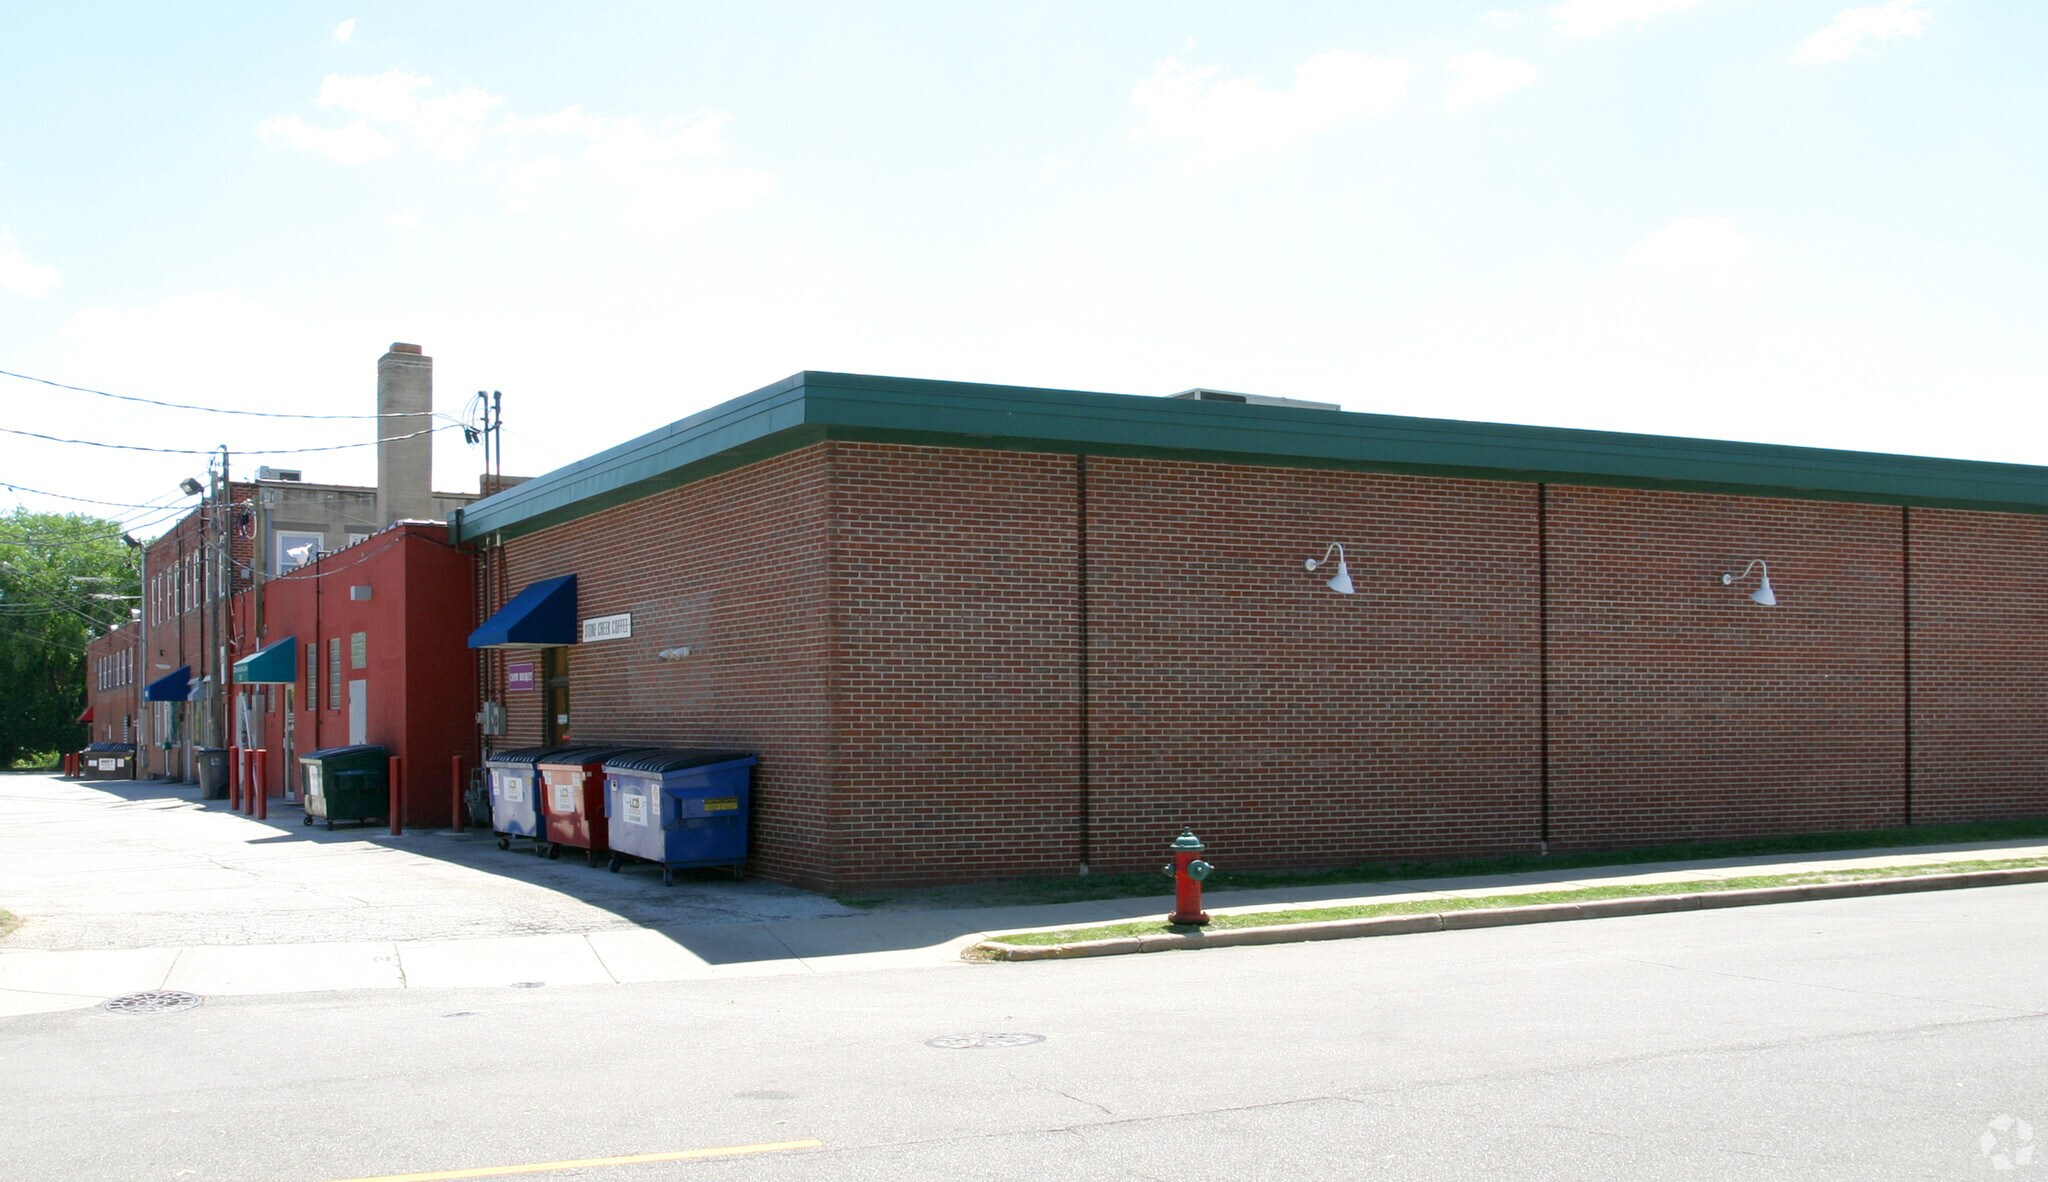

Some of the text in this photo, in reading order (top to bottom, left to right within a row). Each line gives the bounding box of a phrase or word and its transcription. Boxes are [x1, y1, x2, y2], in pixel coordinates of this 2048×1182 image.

[584, 618, 628, 638] STONE CREEK COFFEE
